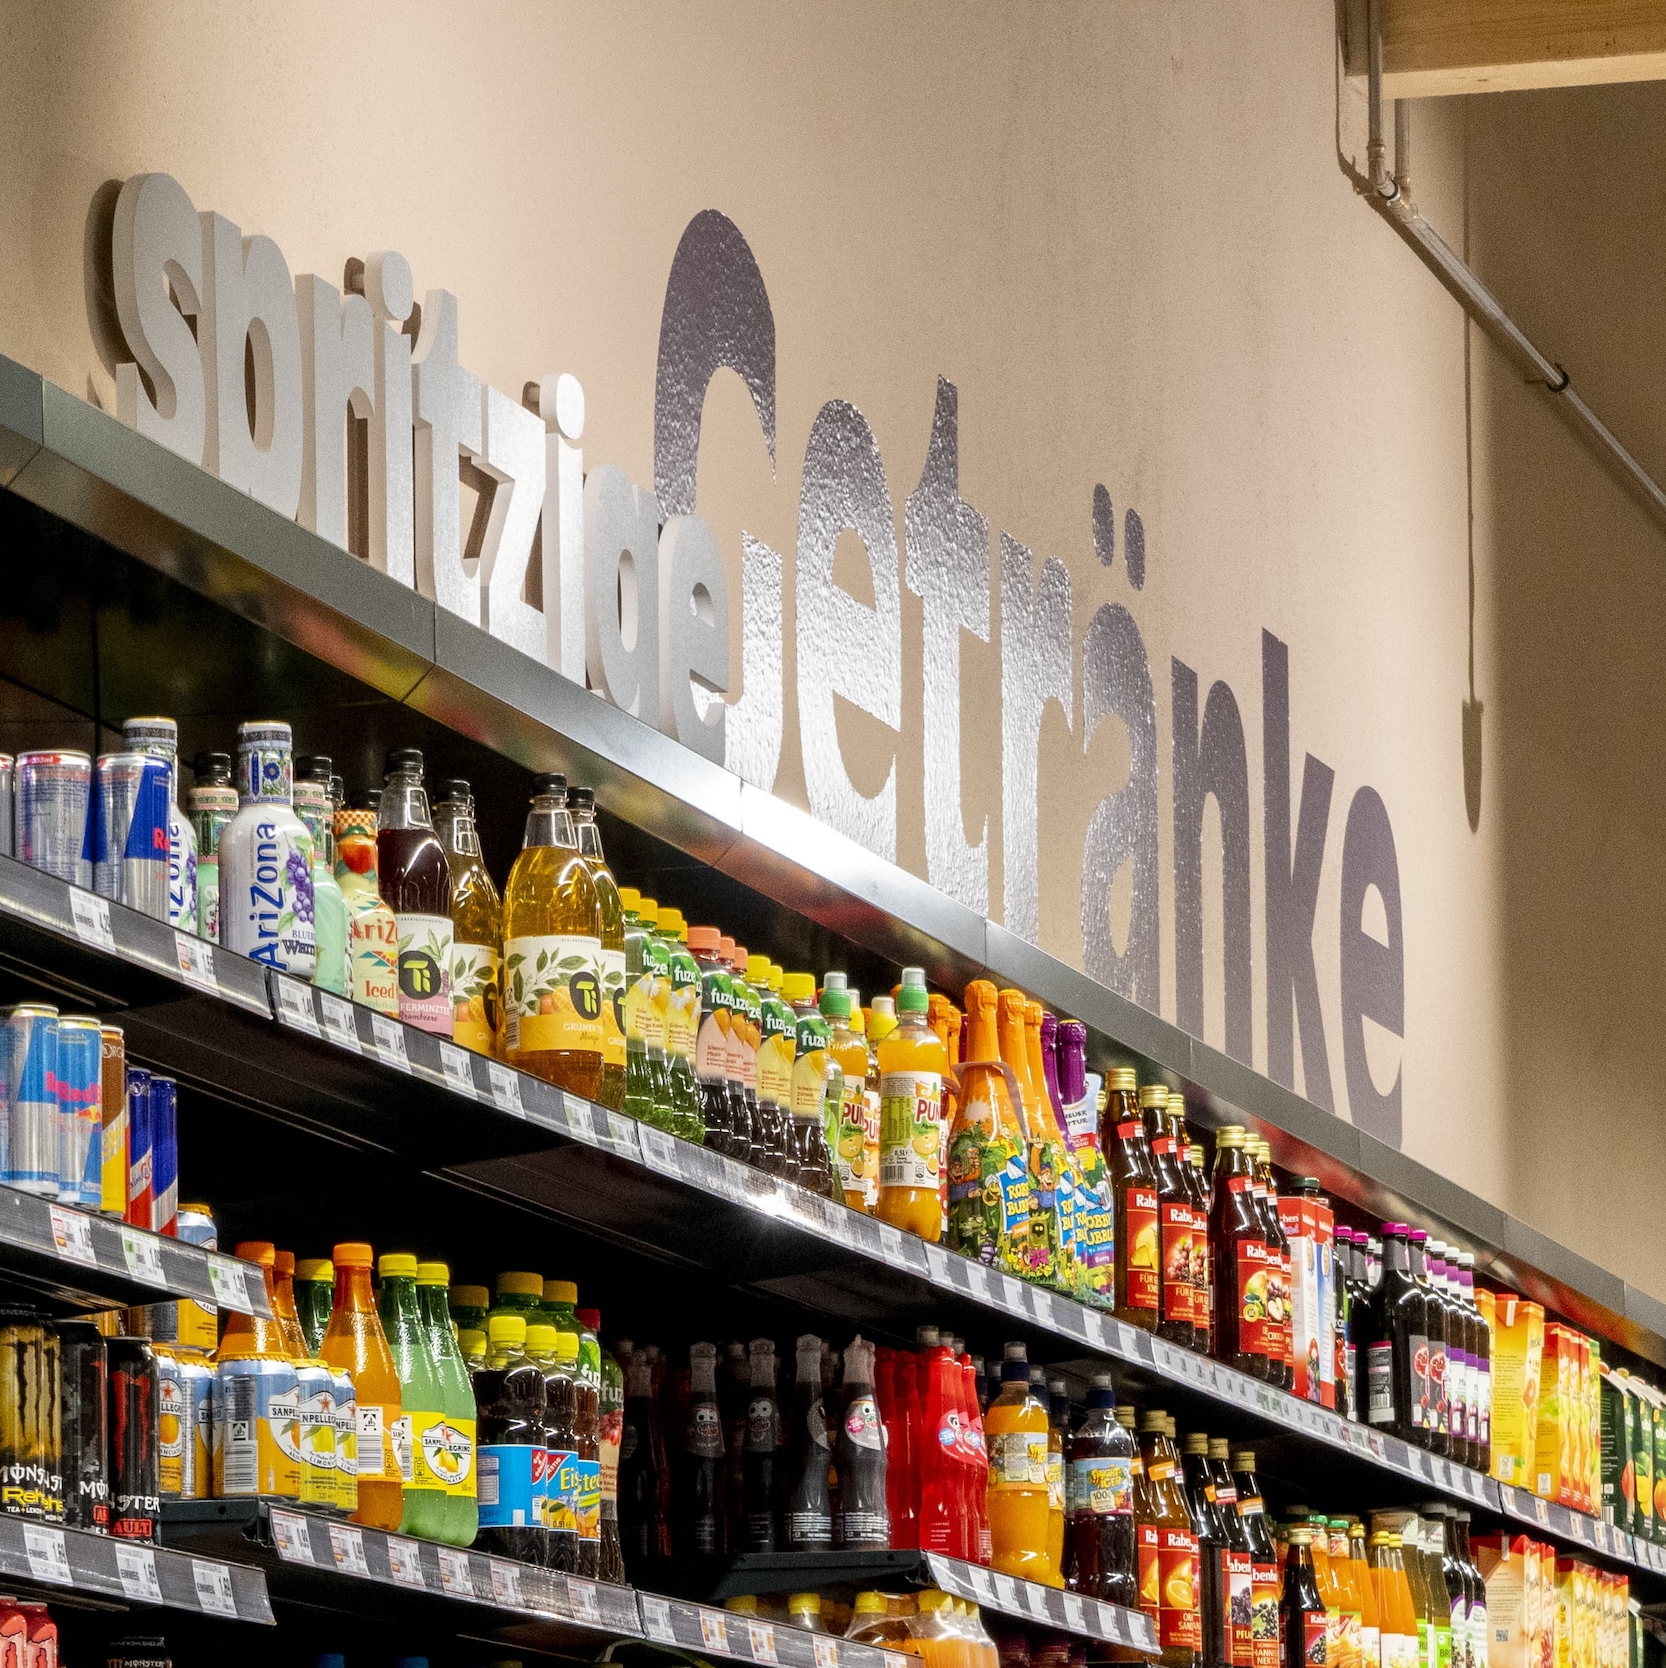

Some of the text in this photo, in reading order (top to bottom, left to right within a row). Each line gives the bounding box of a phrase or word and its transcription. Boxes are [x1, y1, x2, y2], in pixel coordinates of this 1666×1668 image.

[653, 208, 1403, 1148] Getränke
[249, 821, 287, 972] AriZona
[365, 981, 394, 999] Iced
[801, 1030, 826, 1048] fuze
